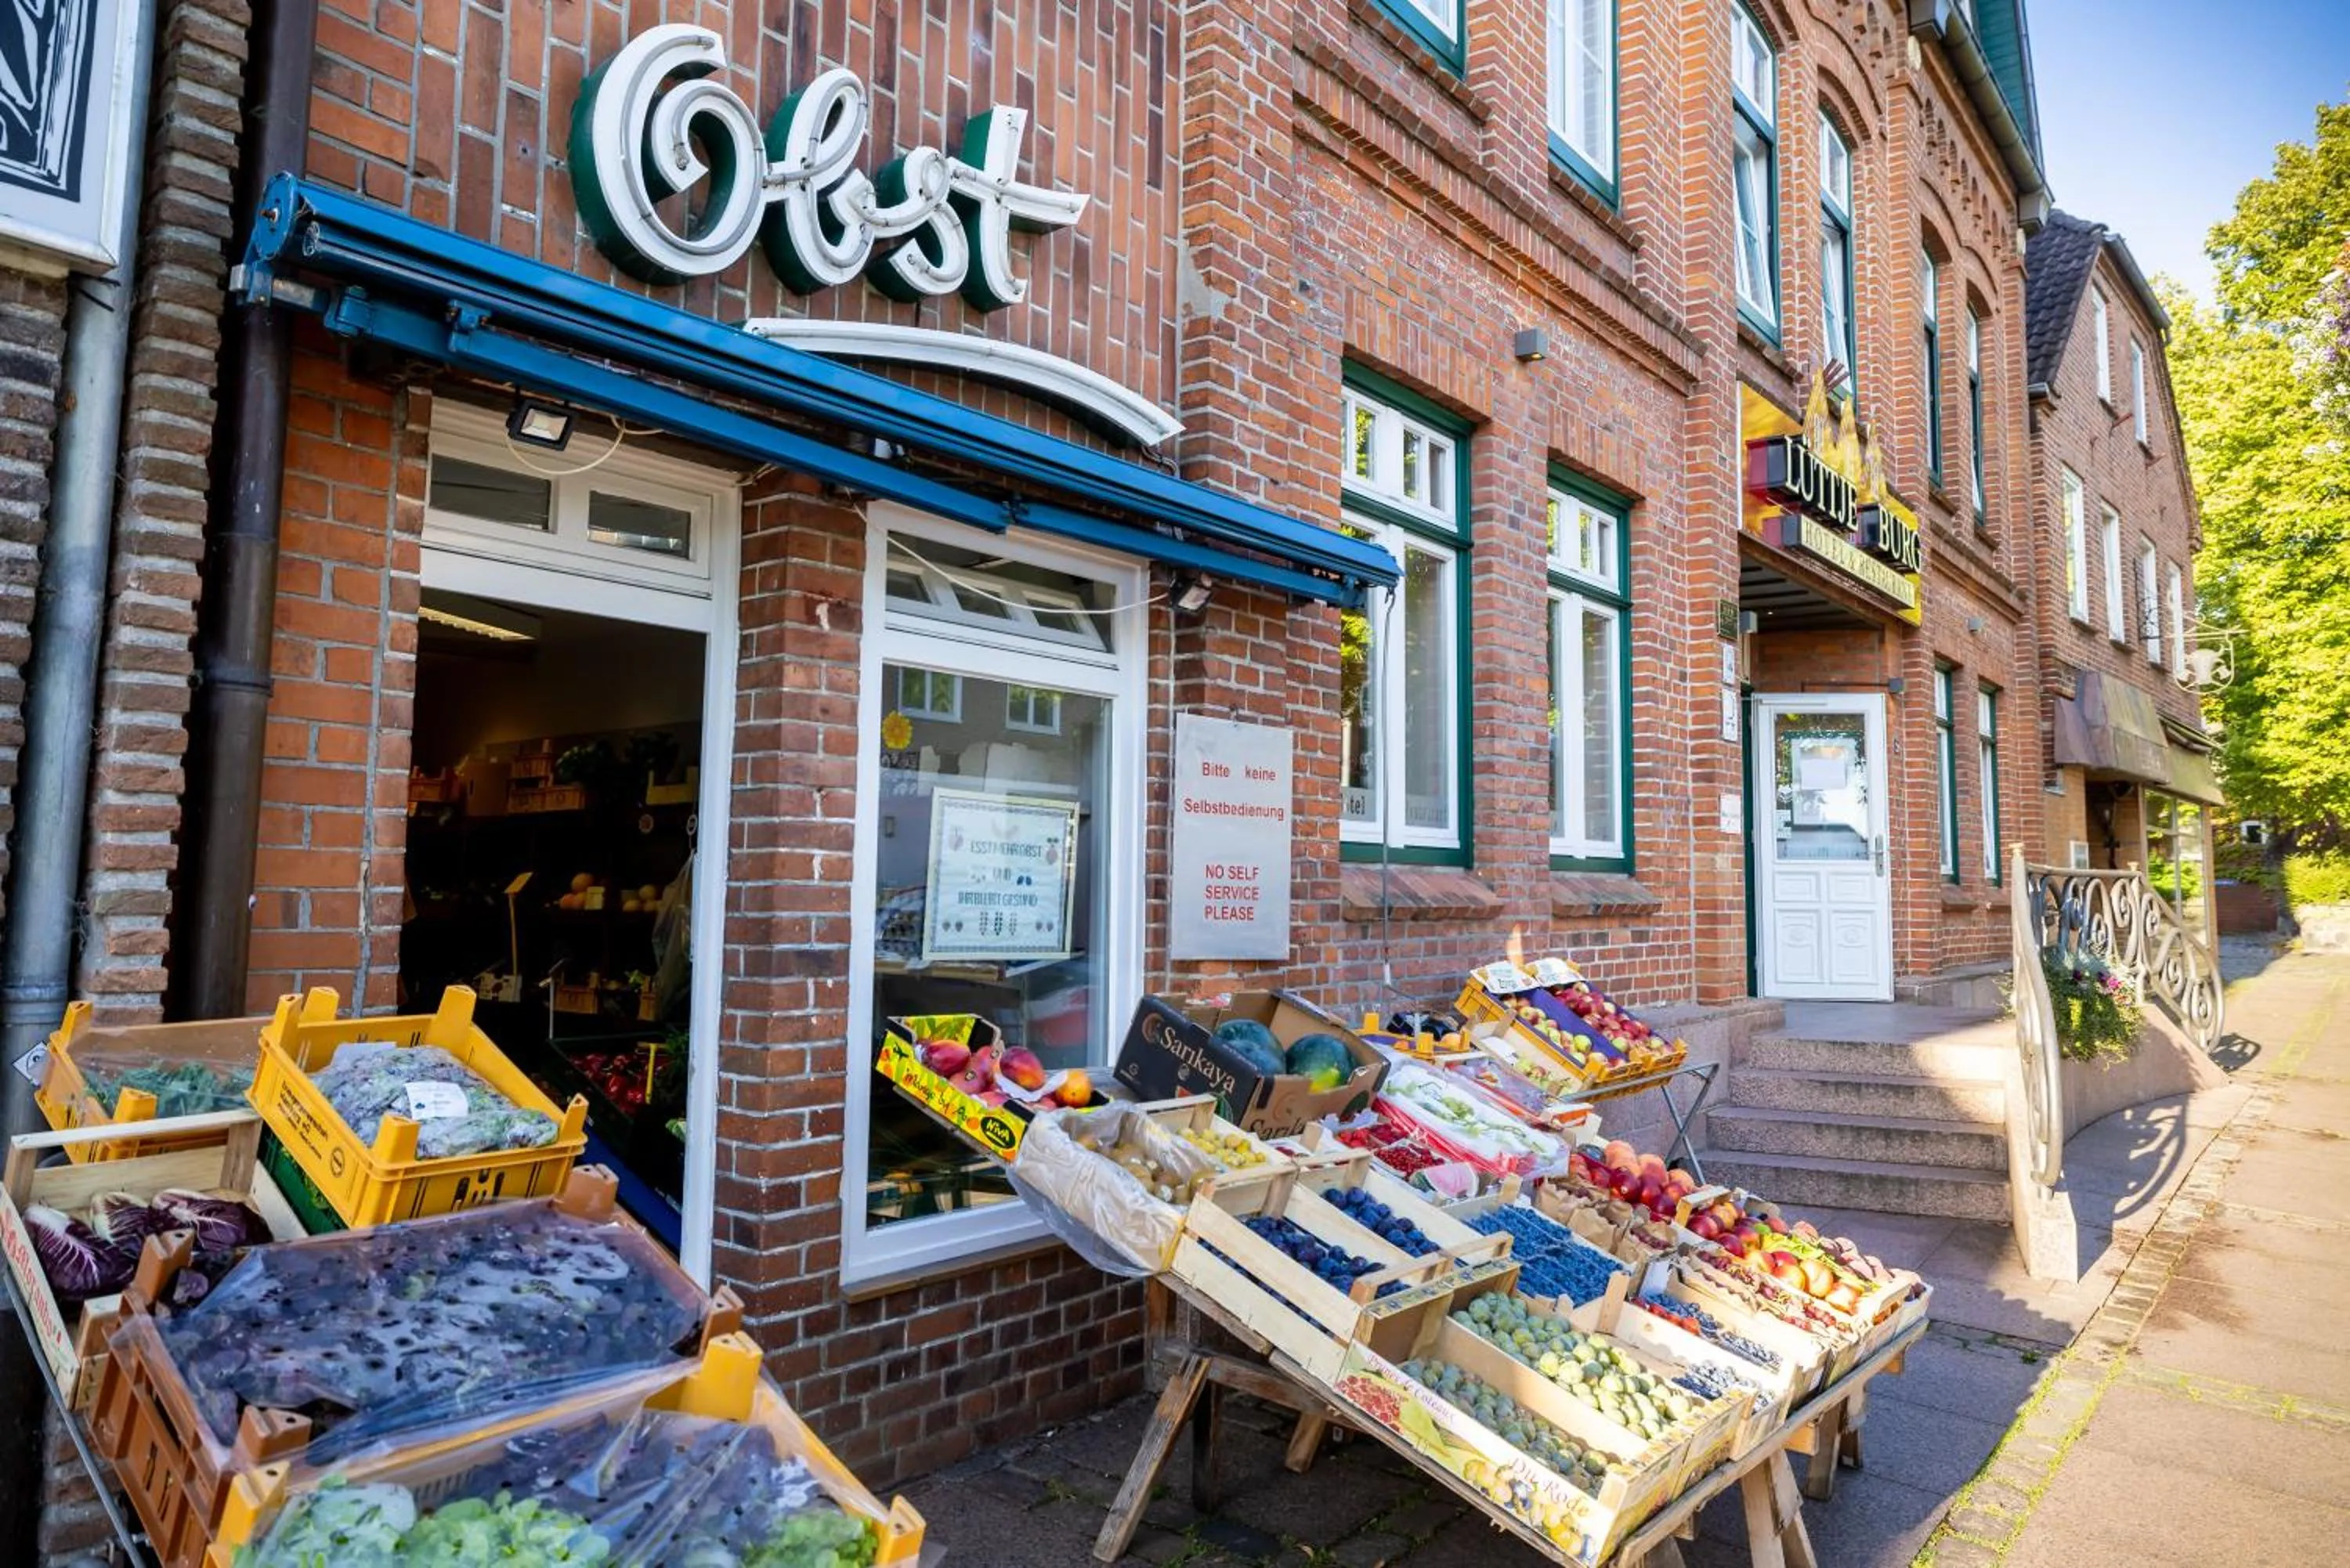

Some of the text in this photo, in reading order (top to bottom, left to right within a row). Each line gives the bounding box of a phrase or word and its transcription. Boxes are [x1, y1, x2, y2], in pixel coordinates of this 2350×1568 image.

[573, 23, 1090, 310] Obst
[1804, 520, 1846, 565] HOTEL
[1879, 504, 1922, 573] BURG
[1202, 762, 1277, 781] Bitte keine
[1184, 797, 1285, 822] Selbstbedienung
[1205, 864, 1260, 880] NO SELF
[1205, 886, 1260, 901] SERVICE
[1204, 905, 1255, 921] PLEASE
